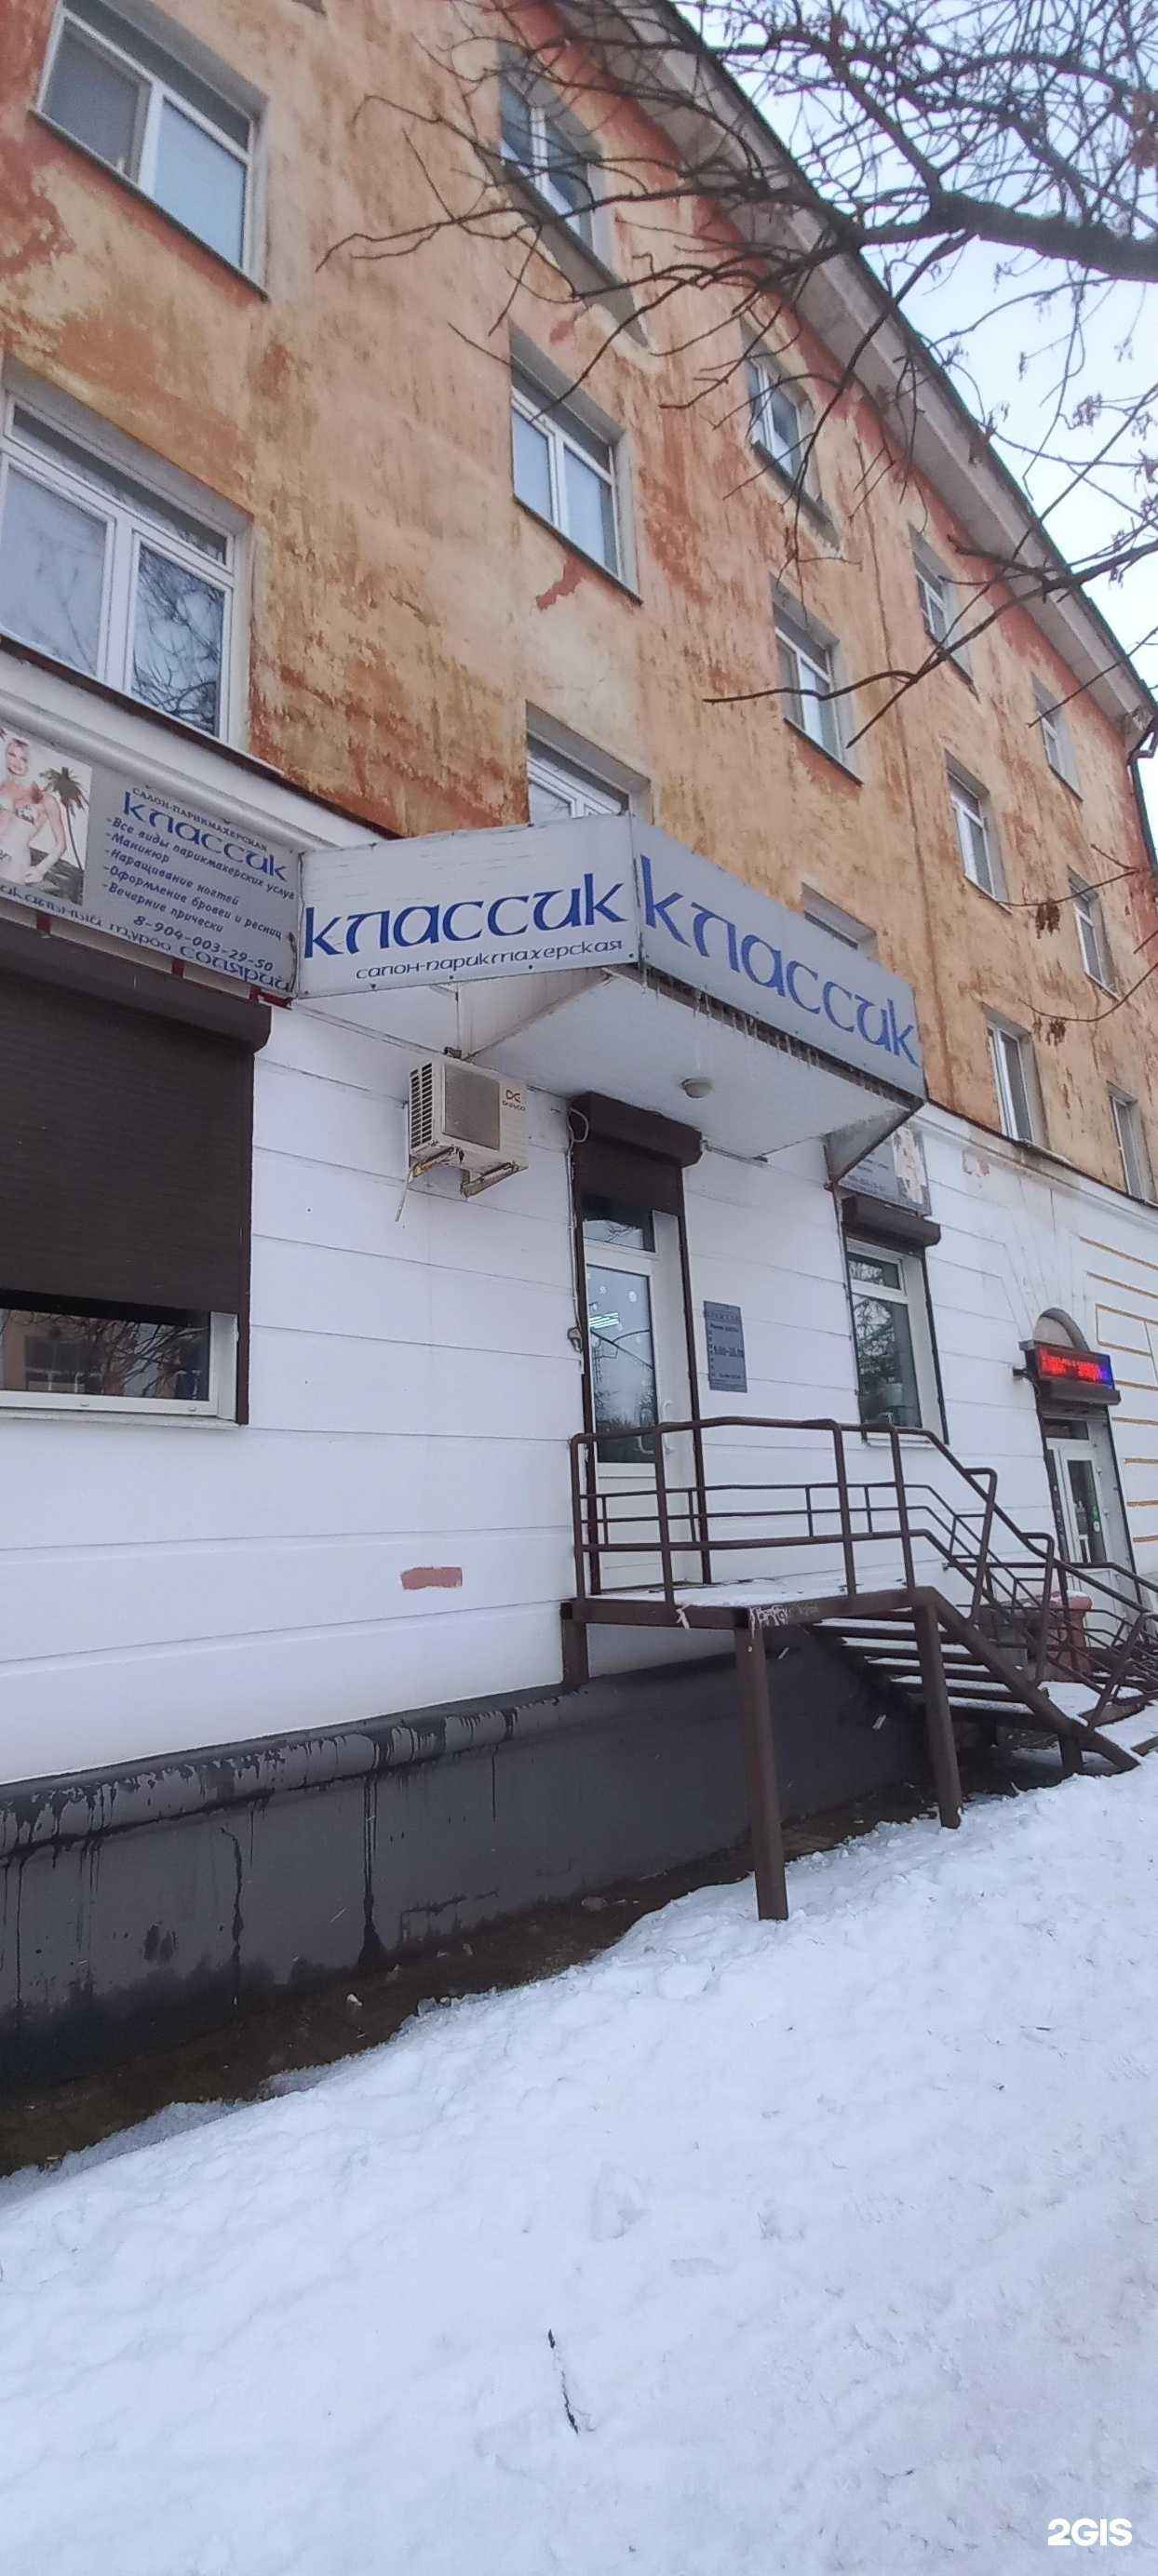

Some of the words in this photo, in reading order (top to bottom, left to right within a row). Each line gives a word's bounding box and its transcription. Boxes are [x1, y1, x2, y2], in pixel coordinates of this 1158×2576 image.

[132, 787, 269, 852] САЛОН-ПАРИКМАХЕРСКАЯ
[139, 828, 170, 849] виды
[172, 842, 263, 888] парикмахерских
[265, 879, 296, 901] услуг
[196, 882, 240, 906] ногтей
[170, 905, 224, 933] прически
[235, 913, 242, 923] и
[243, 916, 283, 942] ресниц
[132, 914, 275, 973] 8-904-003-29-50
